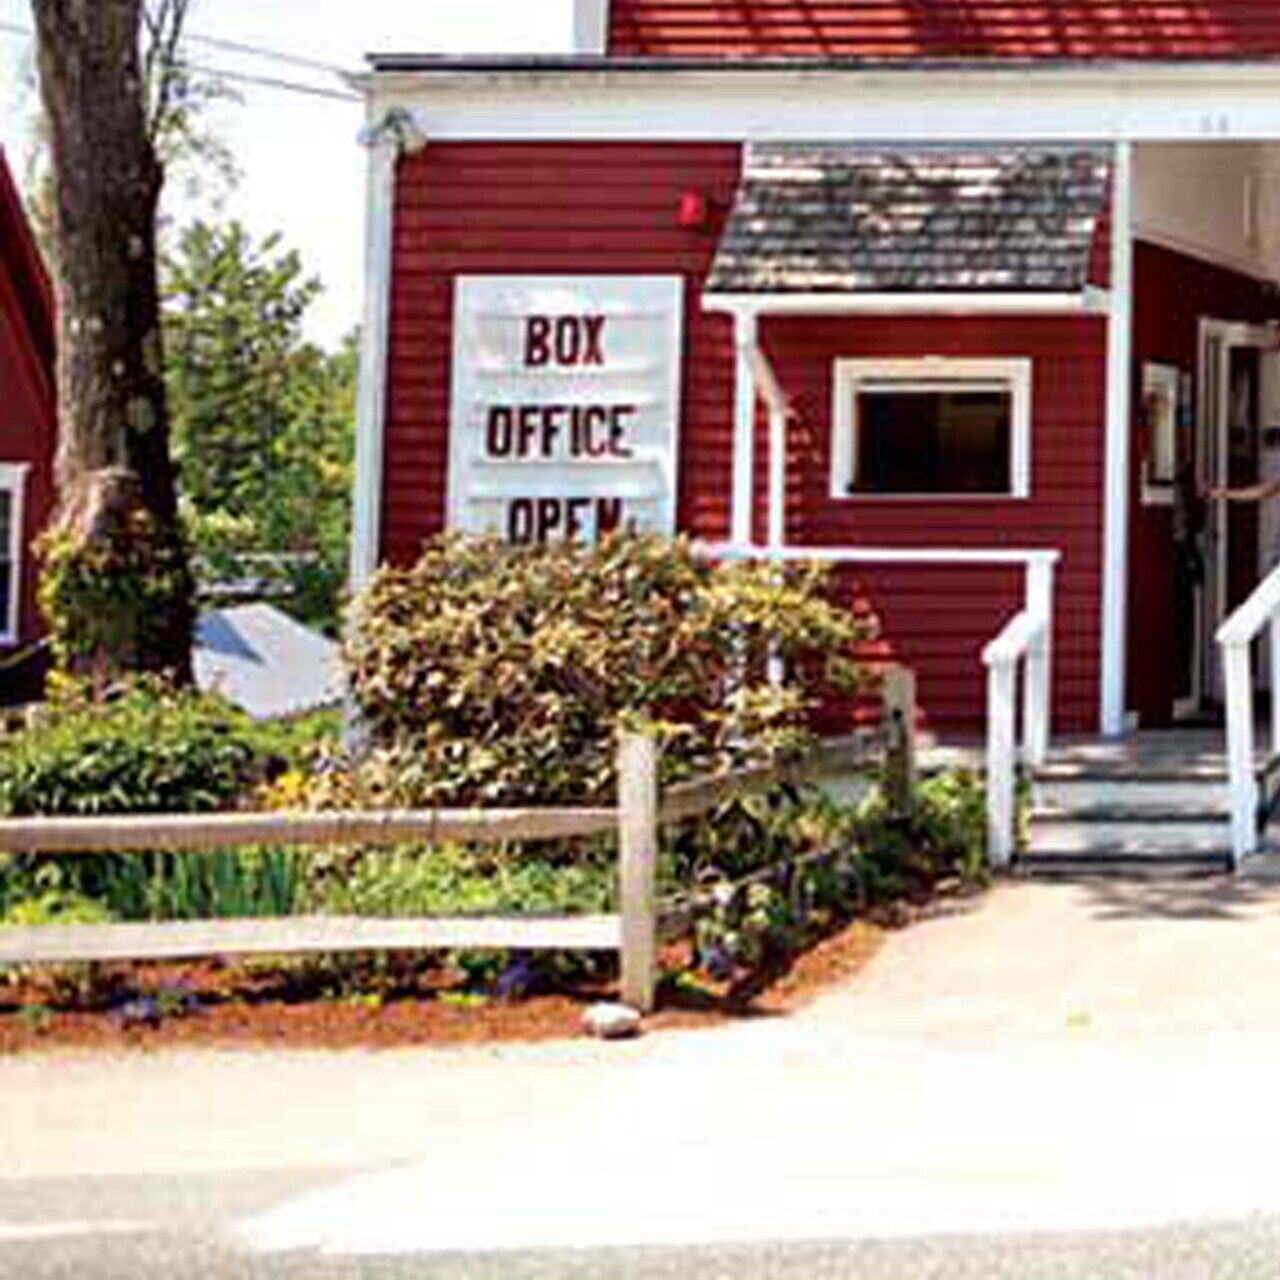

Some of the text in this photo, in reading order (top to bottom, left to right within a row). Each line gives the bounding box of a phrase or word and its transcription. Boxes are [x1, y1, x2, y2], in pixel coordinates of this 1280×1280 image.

[524, 315, 605, 367] BOX
[487, 404, 637, 457] OFFICE
[508, 497, 622, 546] OPEN
